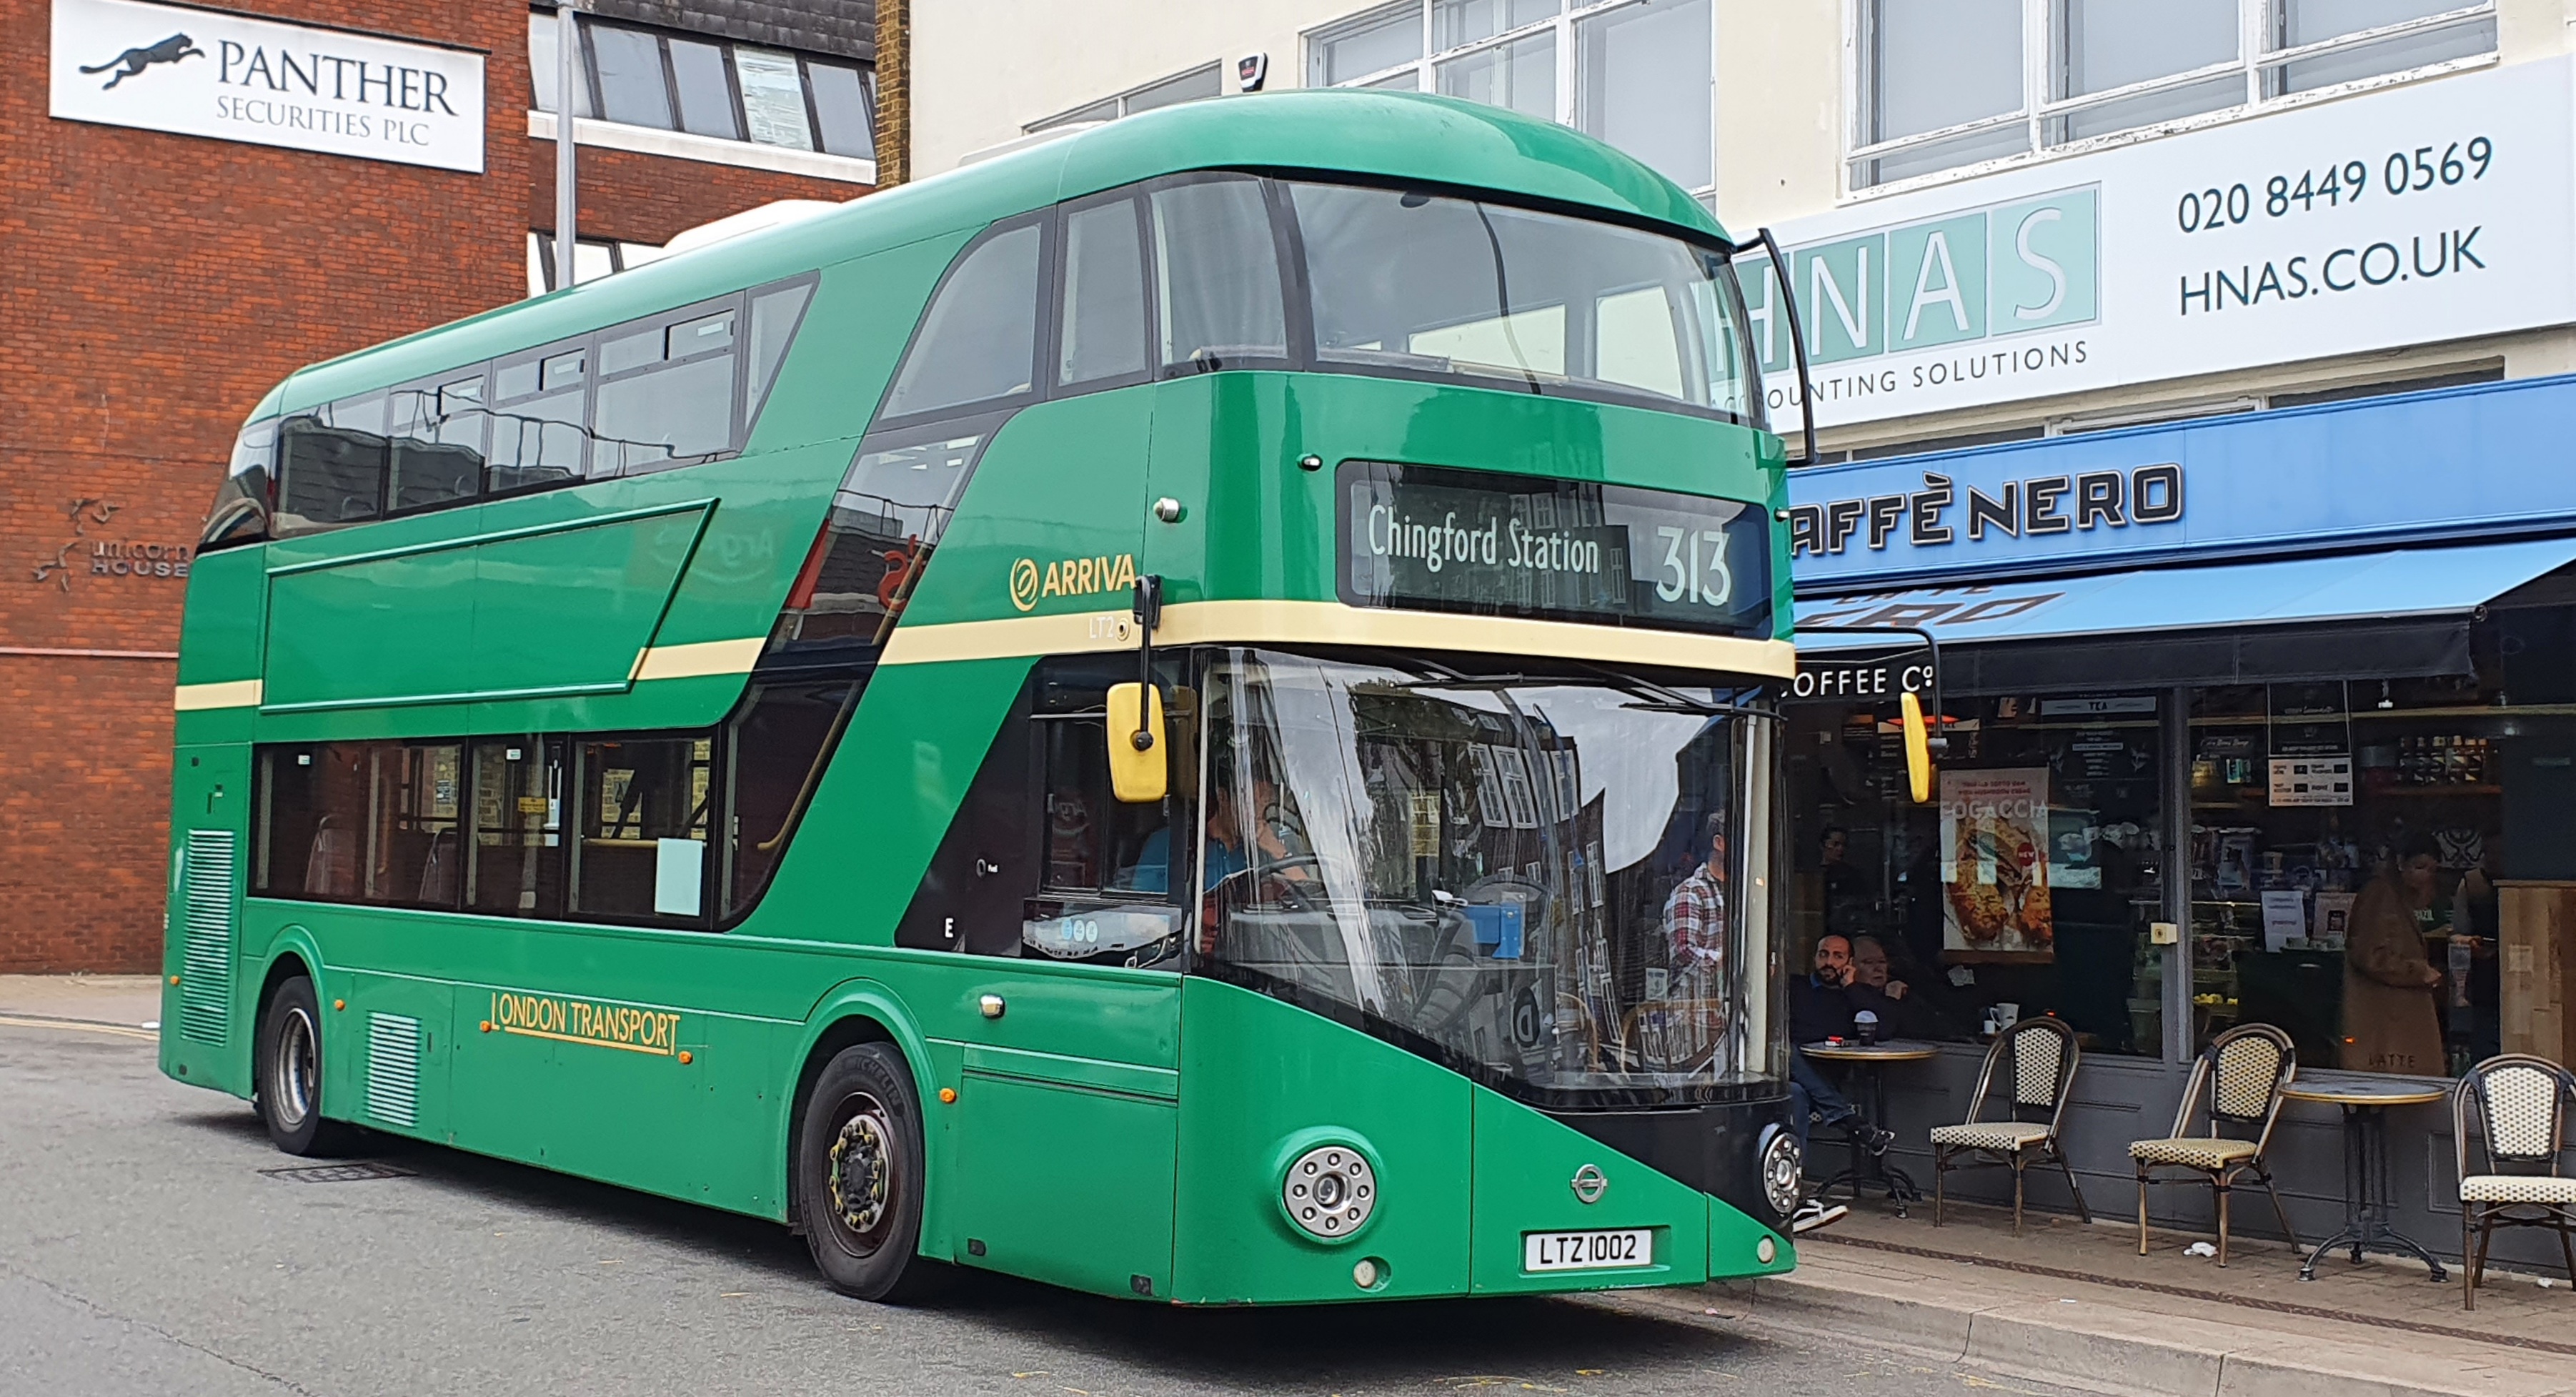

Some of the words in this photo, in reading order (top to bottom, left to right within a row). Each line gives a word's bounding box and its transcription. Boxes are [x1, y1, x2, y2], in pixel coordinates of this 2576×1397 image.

[217, 39, 459, 116] PANTHER
[216, 94, 371, 139] SECURITIES
[384, 120, 430, 146] PLC
[2177, 182, 2252, 234] 020
[2266, 159, 2367, 219] 8449
[2384, 136, 2494, 197] 0569
[2180, 225, 2487, 317] HNAS.CO.UK
[1913, 340, 2087, 388] SOLUTIONS
[1368, 503, 1497, 572] Chingford
[1508, 517, 1599, 574] Station
[1791, 471, 1954, 557] AFFÈ
[1966, 462, 2183, 540] NERO
[91, 559, 189, 577] HOUSE
[1041, 553, 1138, 598] ARRIVA
[1655, 525, 1733, 607] 313
[1088, 617, 1115, 640] LT2
[1782, 668, 1887, 697] OFFEE
[945, 918, 954, 938] E
[490, 992, 566, 1033] LONDON
[571, 1001, 680, 1056] TRANSPORT
